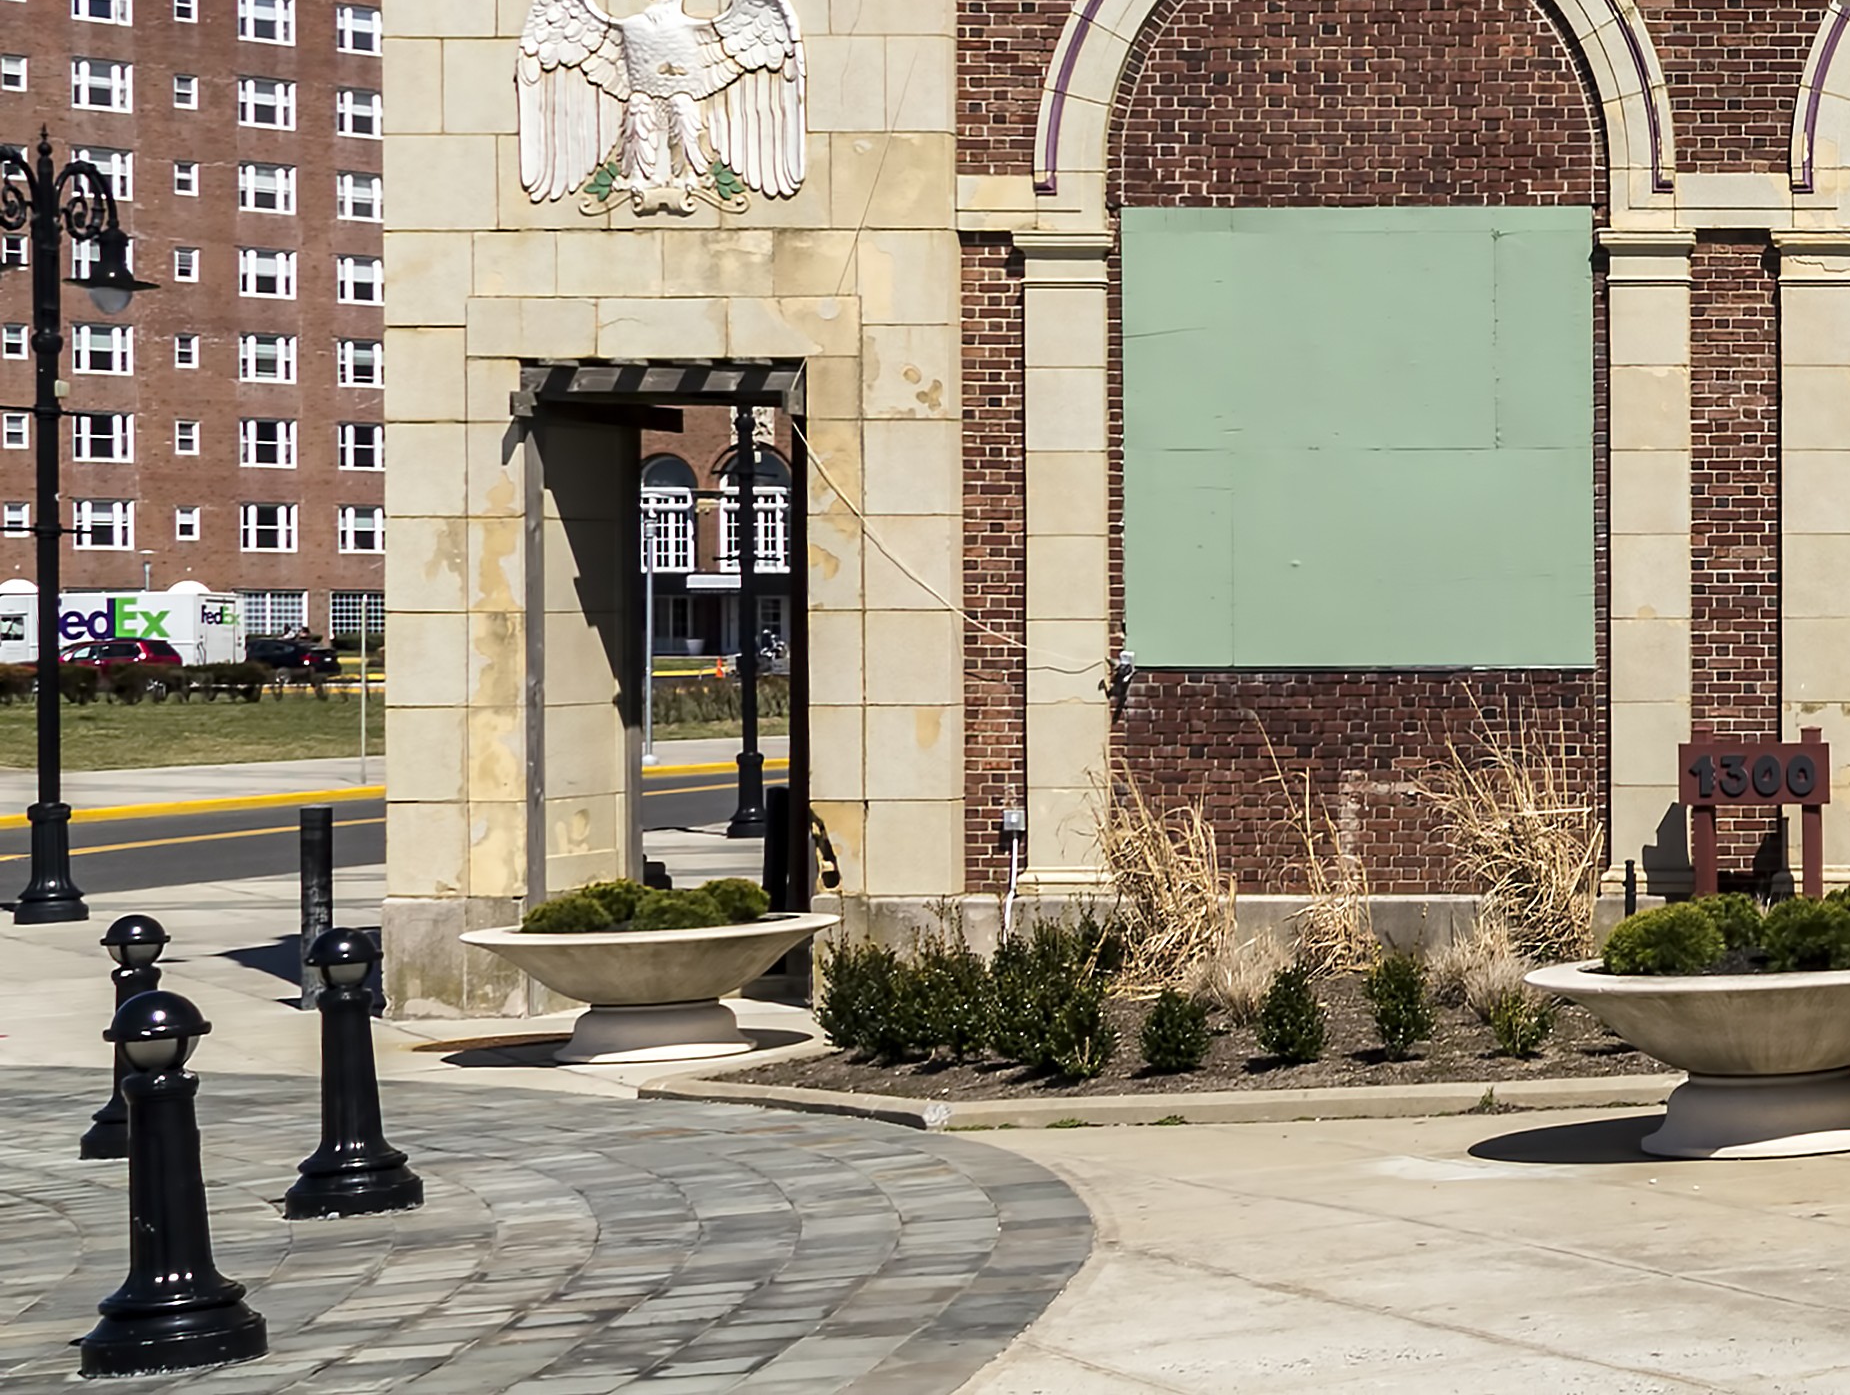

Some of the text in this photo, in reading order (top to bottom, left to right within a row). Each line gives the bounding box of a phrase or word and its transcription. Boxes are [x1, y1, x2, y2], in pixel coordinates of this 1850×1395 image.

[59, 597, 171, 640] edEx
[201, 604, 241, 625] FedEx
[1688, 753, 1817, 799] 1300
